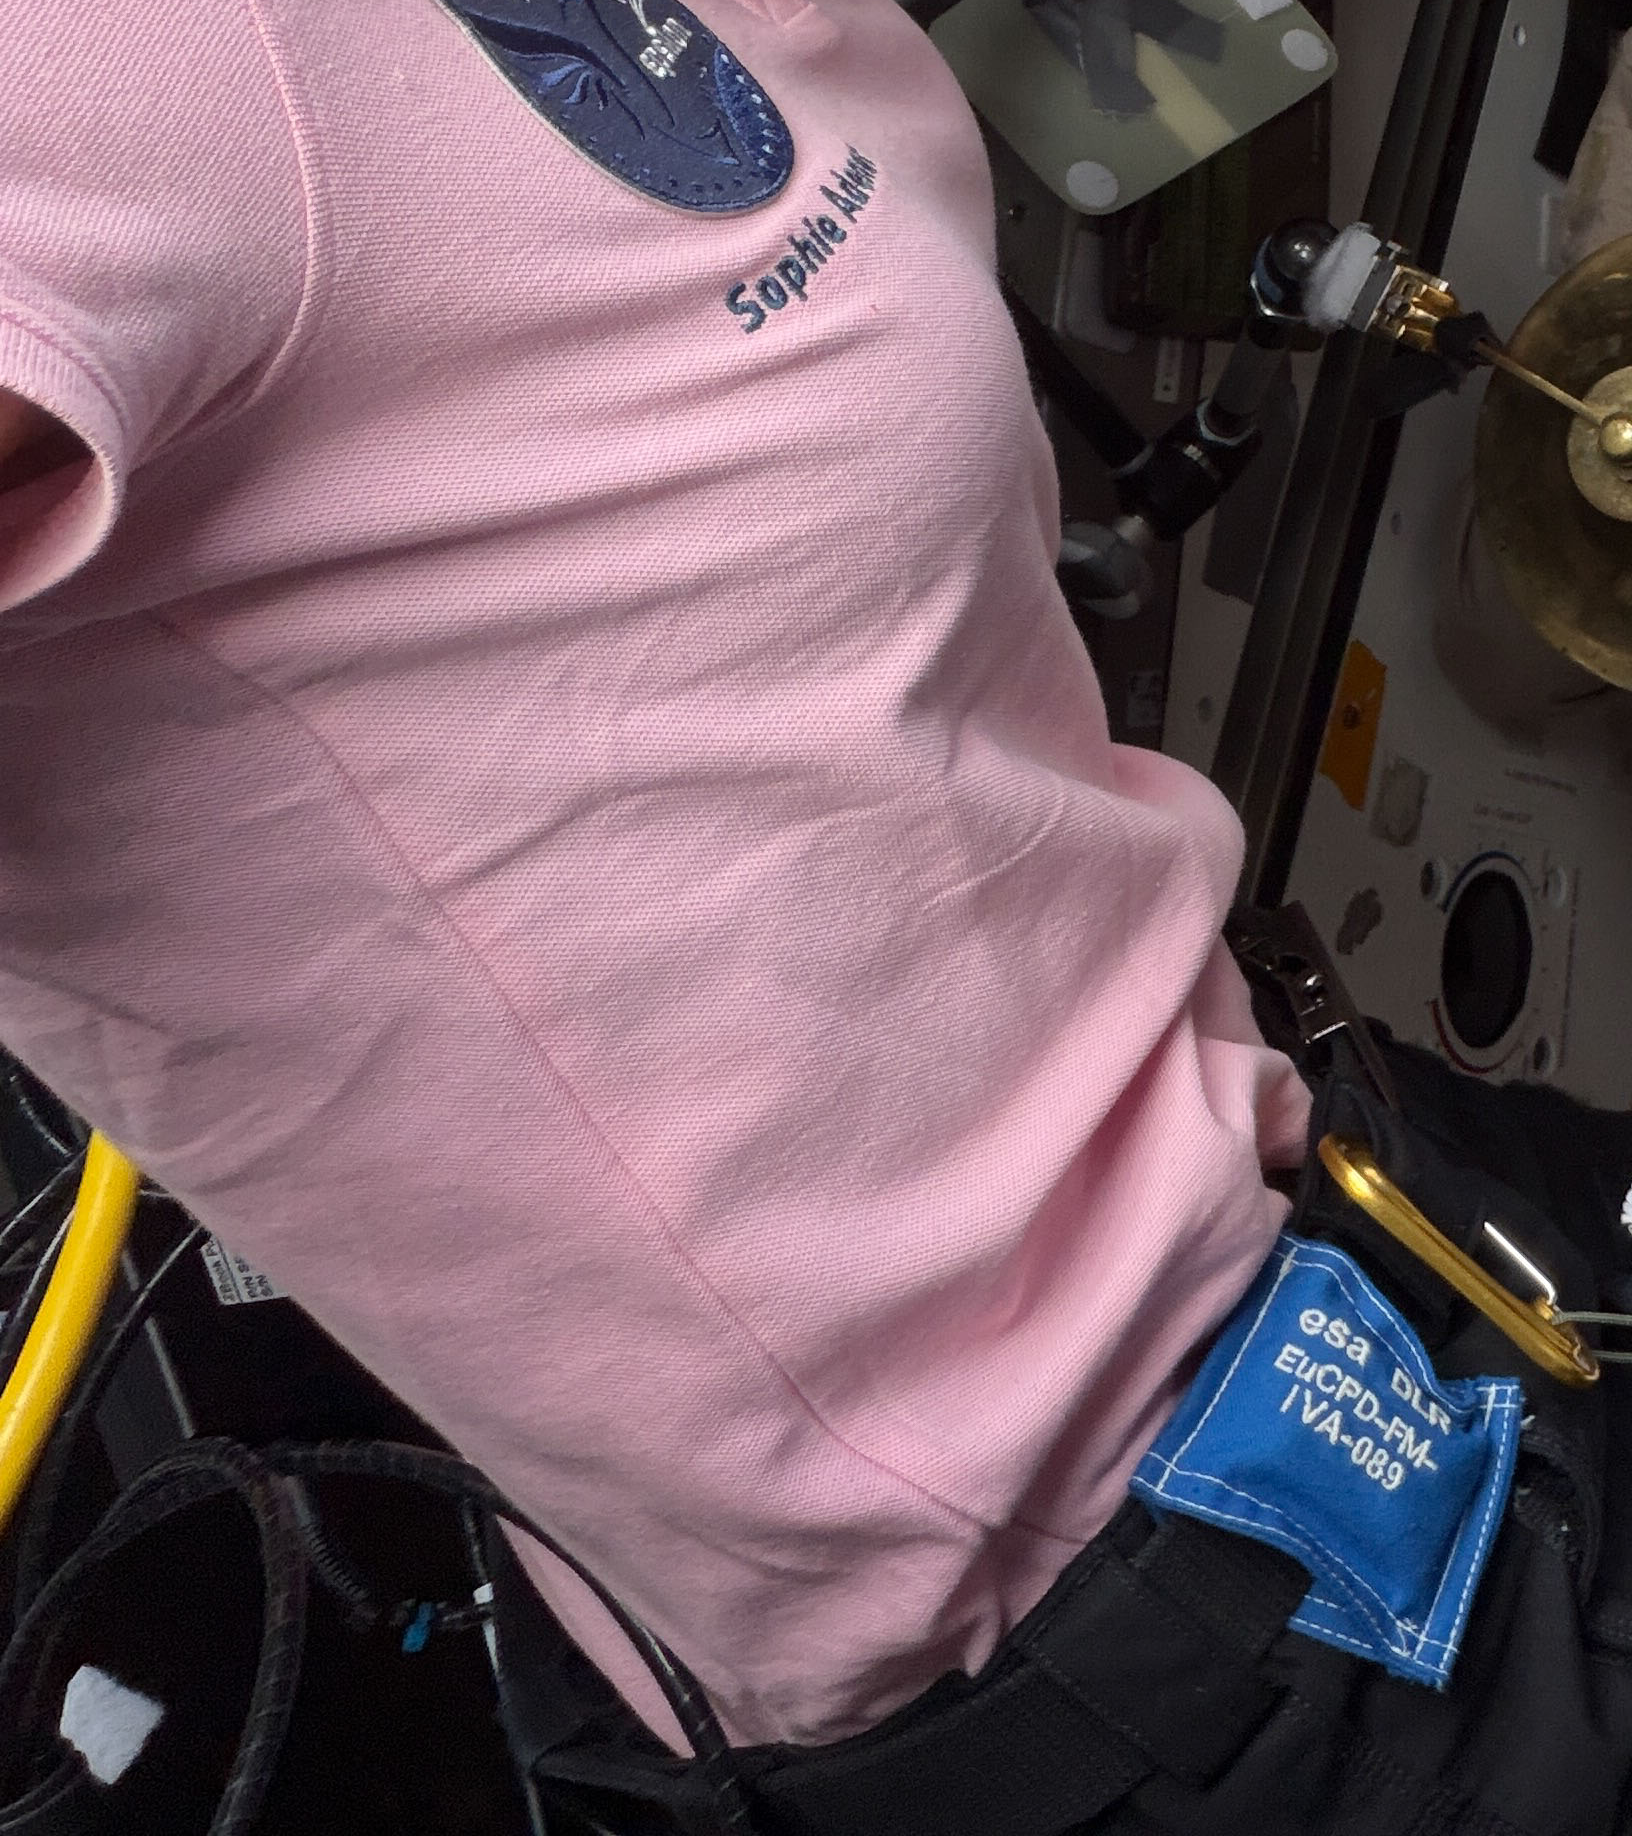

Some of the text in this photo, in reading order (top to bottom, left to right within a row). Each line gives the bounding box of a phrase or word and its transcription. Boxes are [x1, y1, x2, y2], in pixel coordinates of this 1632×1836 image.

[724, 216, 848, 335] Sophie
[1298, 1307, 1453, 1437] esa DLR
[1277, 1384, 1406, 1492] IVA-089
